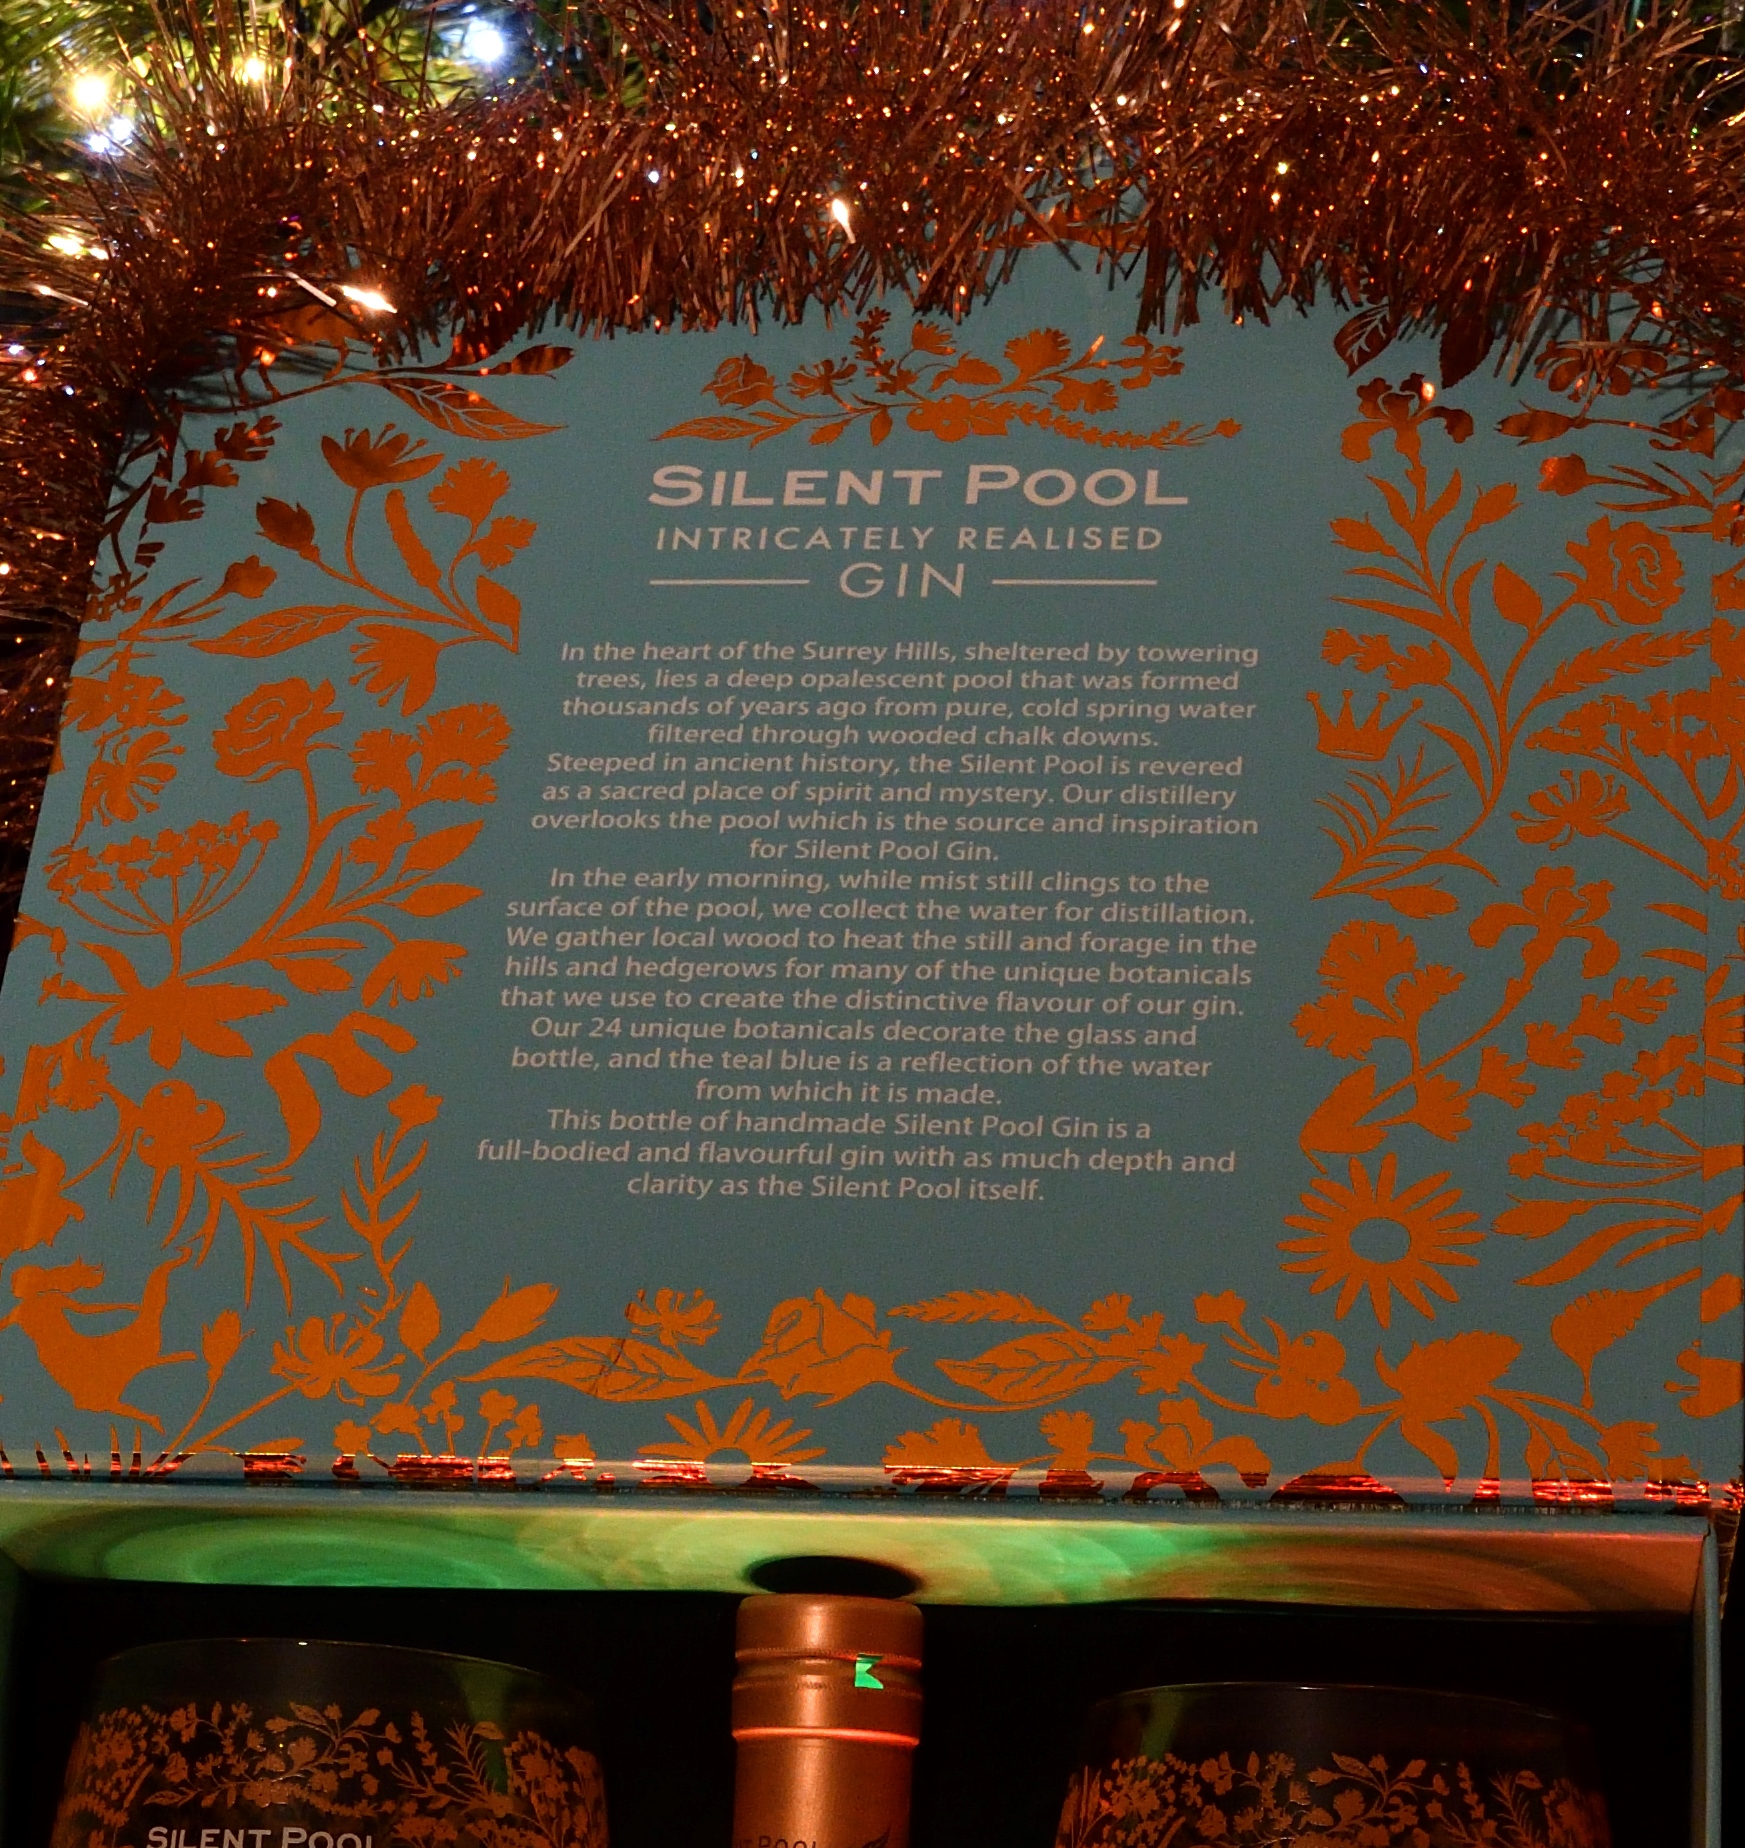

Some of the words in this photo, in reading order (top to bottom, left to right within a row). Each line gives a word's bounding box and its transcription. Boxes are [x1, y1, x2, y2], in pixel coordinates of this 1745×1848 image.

[648, 464, 943, 507] SILENT
[965, 464, 1189, 507] POOL
[656, 527, 934, 550] INTRICATELY
[958, 526, 1162, 550] REALISED
[839, 562, 965, 598] GIN
[561, 643, 585, 661] In
[593, 642, 636, 661] the
[643, 641, 712, 660] heart
[718, 641, 748, 660] of
[752, 641, 795, 660] the
[803, 641, 887, 664] Surrey
[895, 641, 956, 662] Hills,
[965, 641, 1089, 661] sheltered
[1098, 643, 1130, 666] by
[1137, 644, 1258, 668] towering
[577, 672, 645, 690] trees,
[656, 669, 697, 687] lies
[705, 674, 719, 687] a
[727, 669, 793, 691] deep
[801, 669, 945, 692] opalescent
[953, 670, 1012, 692] pool
[1021, 670, 1074, 688] that
[1083, 675, 1132, 689] was
[1142, 670, 1239, 690] formed
[563, 696, 699, 716] thousands
[707, 696, 735, 715] of
[740, 701, 809, 720] years
[817, 701, 866, 720] ago
[875, 696, 937, 715] from
[945, 702, 1012, 720] pure,
[1022, 698, 1078, 717] cold
[1087, 703, 1170, 723] spring
[1179, 702, 1256, 719] water
[649, 723, 743, 743] filtered
[752, 724, 858, 748] through
[868, 725, 977, 744] wooded
[985, 726, 1054, 745] chalk
[1063, 726, 1158, 746] downs.
[547, 1108, 601, 1130] This
[609, 1109, 692, 1131] bottle
[700, 1110, 730, 1131] of
[736, 1110, 886, 1134] handmade
[895, 1113, 973, 1135] Silent
[982, 1115, 1044, 1137] Pool
[1052, 1116, 1098, 1137] Gin
[1108, 1118, 1127, 1138] is
[1136, 1123, 1151, 1139] a
[478, 1139, 630, 1162] full-bodied
[638, 1142, 690, 1162] and
[699, 1141, 832, 1164] flavourful
[841, 1145, 884, 1170] gin
[894, 1146, 955, 1166] with
[963, 1152, 992, 1168] as
[1002, 1148, 1080, 1169] much
[1088, 1148, 1172, 1176] depth
[1181, 1151, 1236, 1172] and
